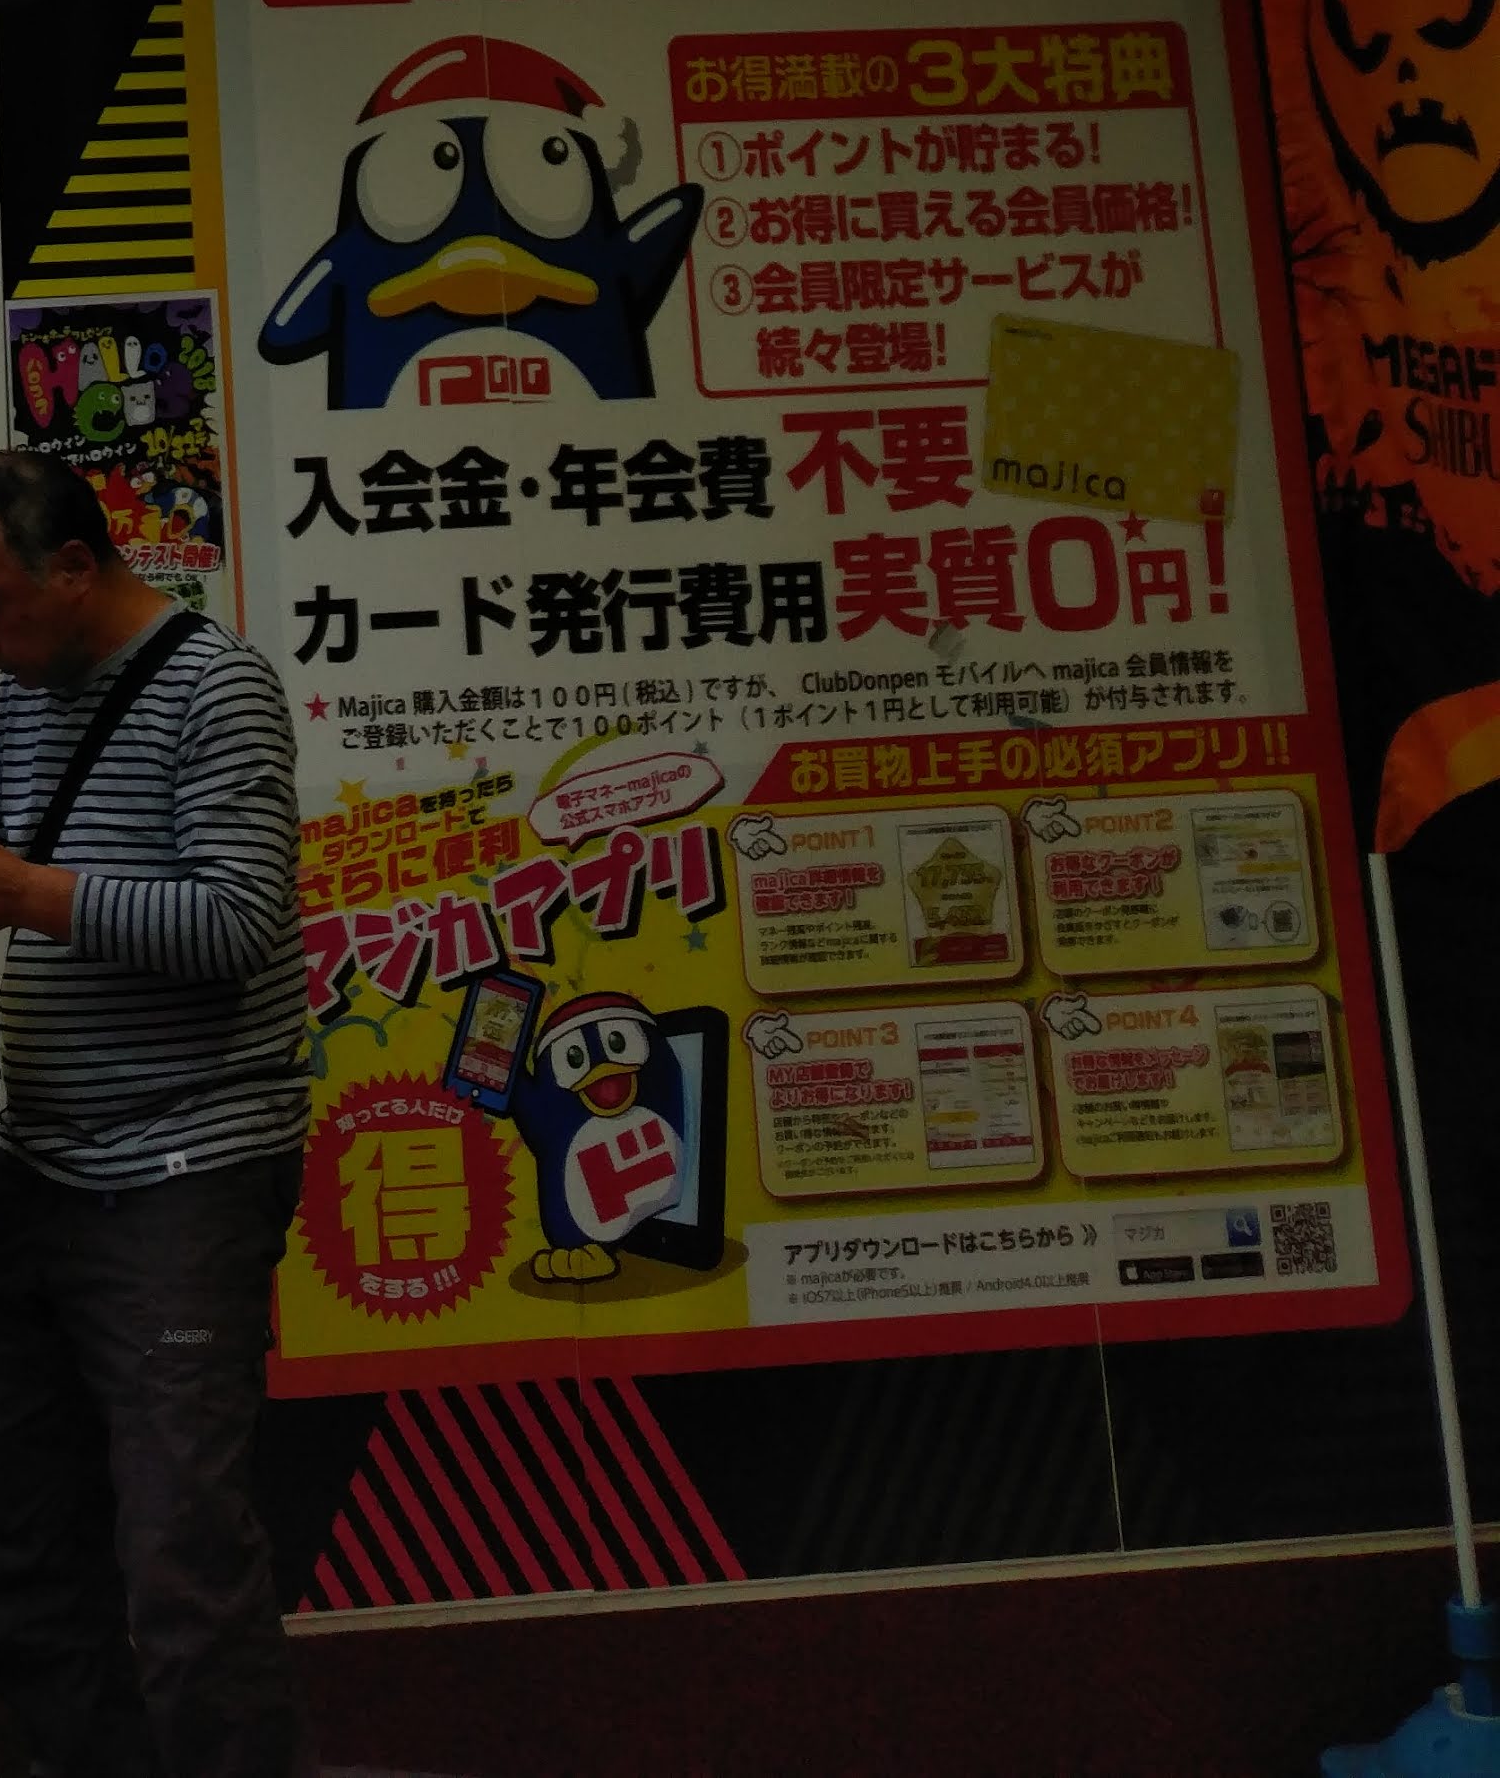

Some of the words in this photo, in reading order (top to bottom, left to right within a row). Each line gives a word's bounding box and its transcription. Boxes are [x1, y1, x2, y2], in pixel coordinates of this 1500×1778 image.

[686, 33, 1174, 106] お得満載の3大特典
[756, 322, 946, 378] 続々登場!
[338, 696, 407, 723] Majica
[801, 668, 929, 696] ClubDonpen
[935, 659, 1046, 687] モバイルへ
[1052, 660, 1120, 685] majica
[1126, 648, 1234, 679] 会員情報を
[301, 824, 718, 1018] マジカアプリ
[335, 1097, 465, 1135] 知ってる人だけ
[337, 1125, 472, 1267] 得
[785, 1224, 1074, 1265] アプリダウンロードはこちらから
[173, 1329, 213, 1344] GERRY
